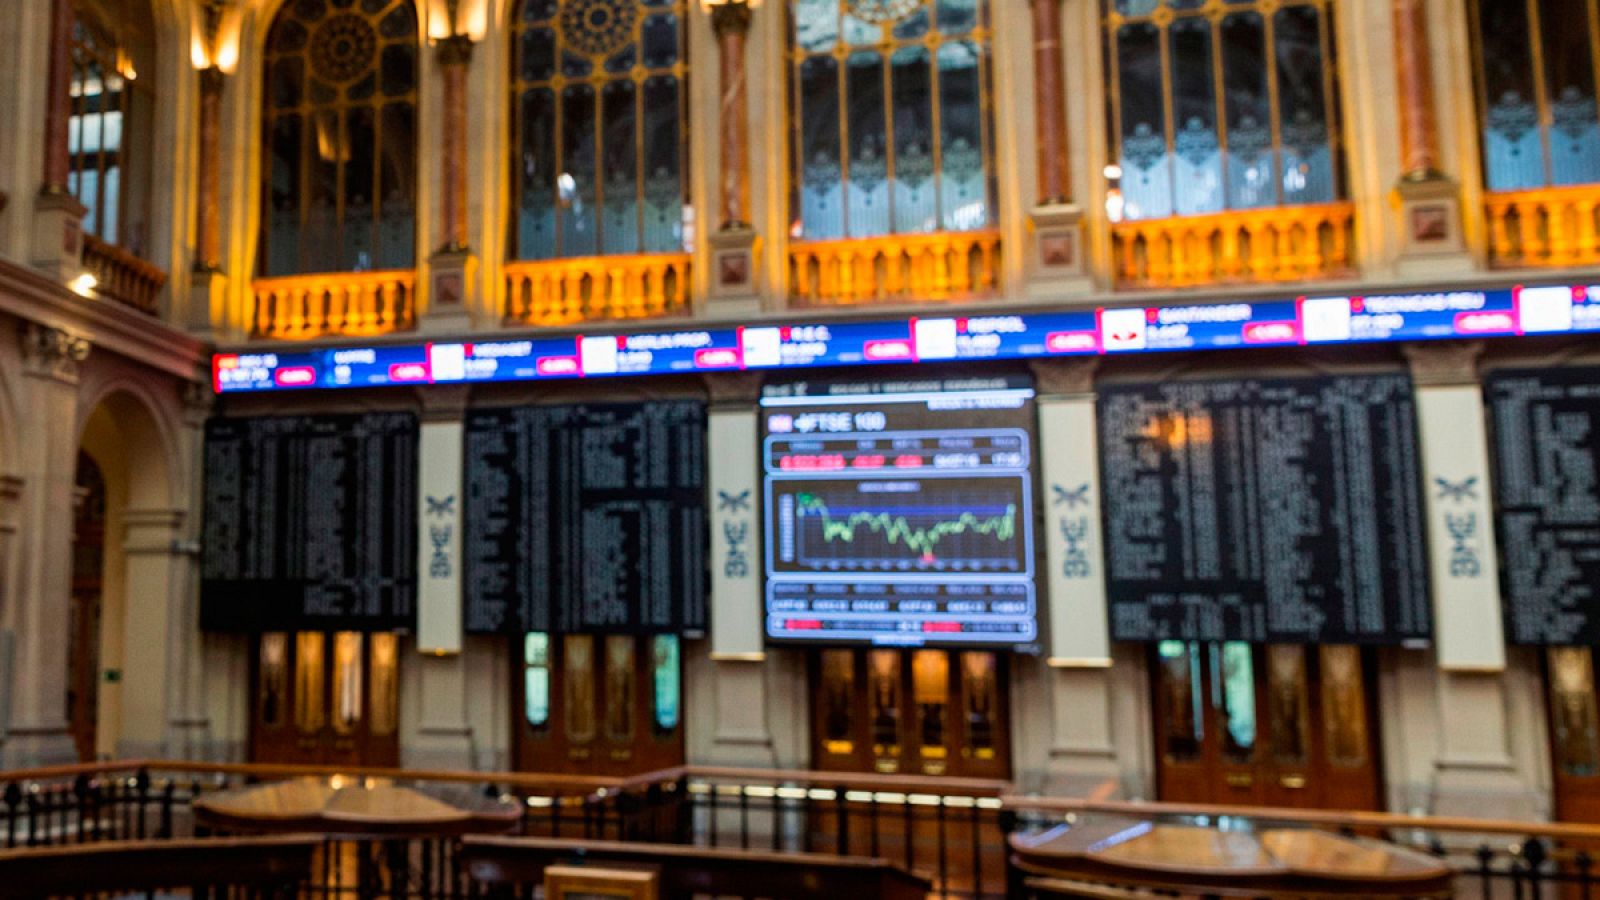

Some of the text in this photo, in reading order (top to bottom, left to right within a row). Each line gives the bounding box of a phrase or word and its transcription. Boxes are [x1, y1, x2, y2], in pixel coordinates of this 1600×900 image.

[1158, 304, 1251, 324] SANTANDER
[808, 412, 886, 432] FTSE 100
[430, 525, 452, 578] BME
[723, 519, 748, 578] BME
[1060, 515, 1089, 577] BME
[1446, 511, 1480, 577] BME
